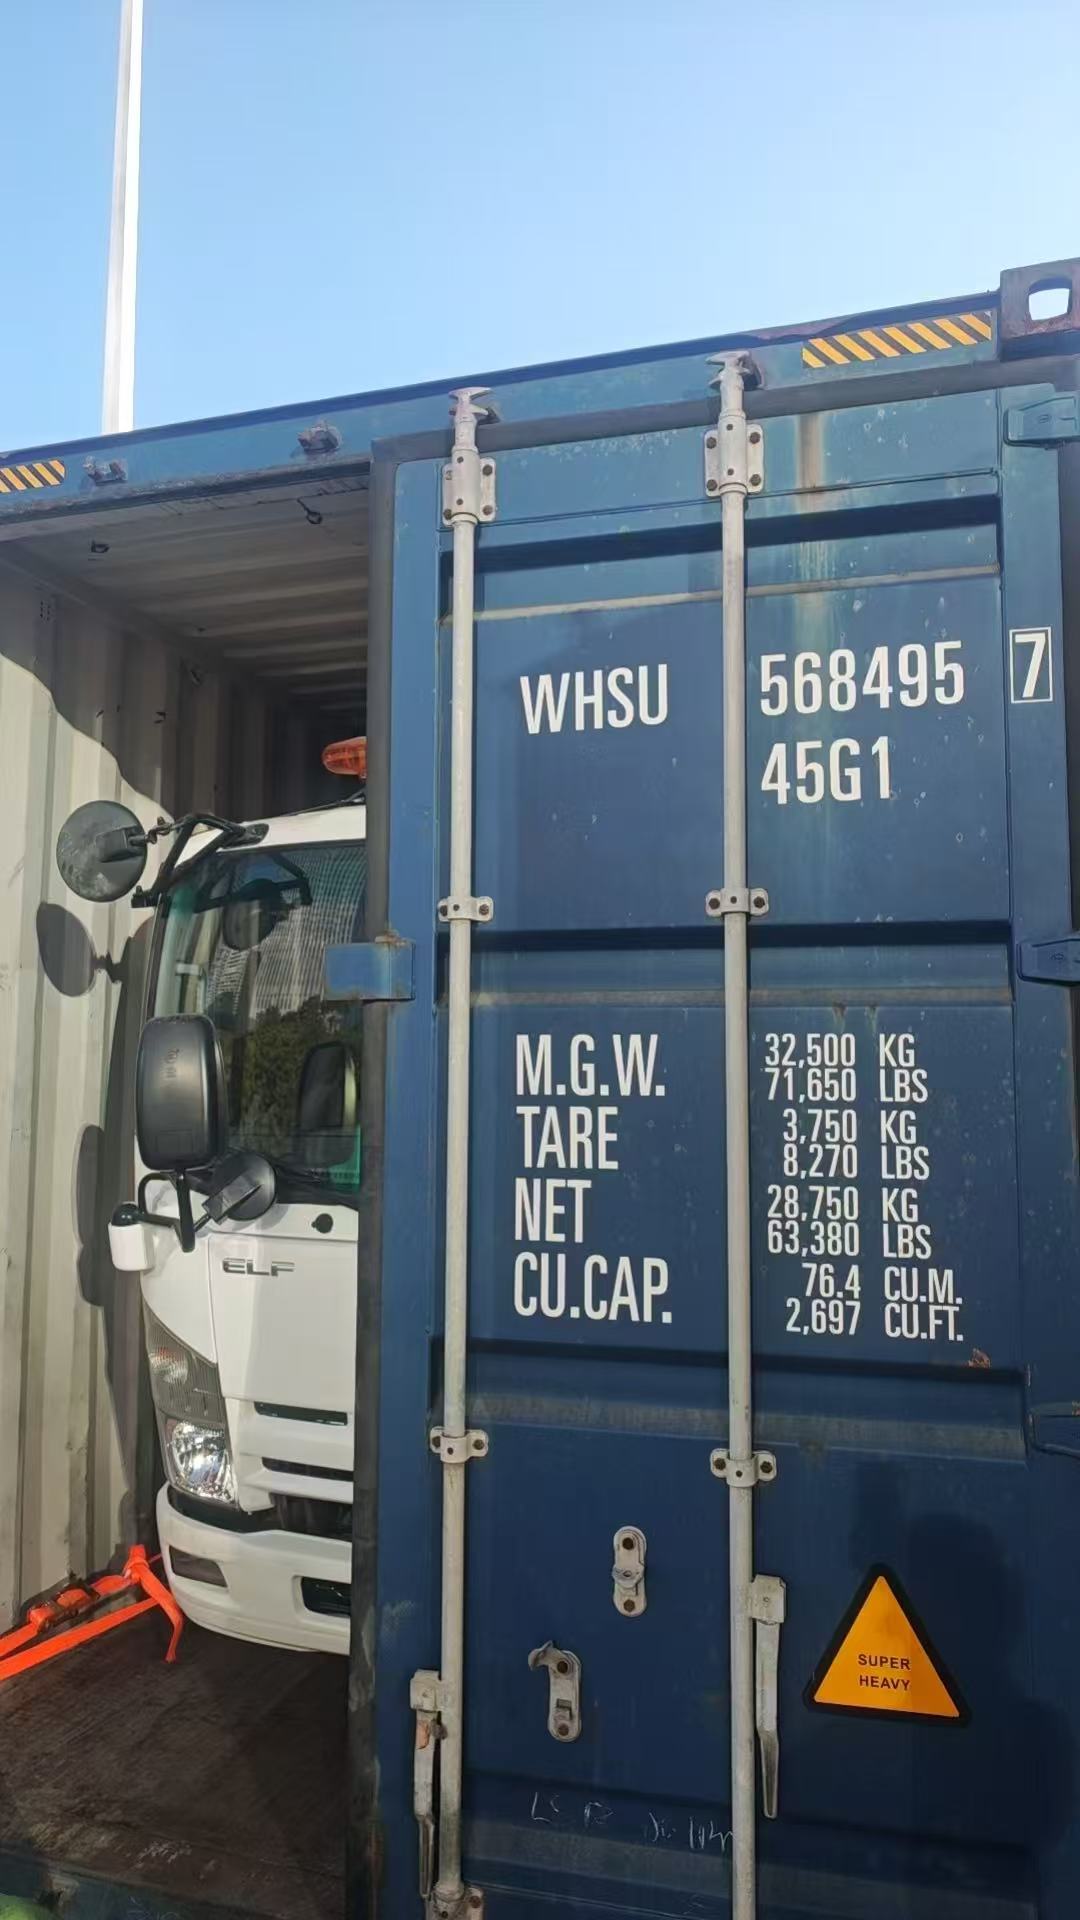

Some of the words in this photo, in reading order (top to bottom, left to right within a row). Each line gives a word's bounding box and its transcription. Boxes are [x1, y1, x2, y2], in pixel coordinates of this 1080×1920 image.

[519, 663, 669, 735] WHSU
[760, 639, 965, 716] 568495
[1014, 631, 1047, 699] 7
[760, 735, 893, 805] 45G1
[516, 1033, 666, 1097] M.G.W.
[765, 1032, 856, 1069] 32,500
[879, 1033, 915, 1068] KG
[764, 1067, 857, 1104] 71,650
[879, 1068, 929, 1104] LBS
[516, 1105, 620, 1170] TARE
[782, 1108, 858, 1145] 3,750
[880, 1109, 917, 1145] KG
[783, 1142, 859, 1179] 8,270
[881, 1144, 930, 1181] LBS
[514, 1177, 592, 1244] NET
[767, 1184, 860, 1221] 28,750
[881, 1187, 919, 1223] KG
[767, 1219, 861, 1257] 63,380
[882, 1223, 932, 1260] LBS
[222, 1257, 295, 1277] ELF
[514, 1251, 673, 1324] CU.CAP.
[801, 1262, 862, 1300] 76.4
[884, 1266, 963, 1305] CU.M.
[786, 1297, 861, 1336] 2,697
[884, 1302, 964, 1342] CU.FT.
[857, 1653, 911, 1670] SUPER
[859, 1674, 911, 1691] HEAVY
